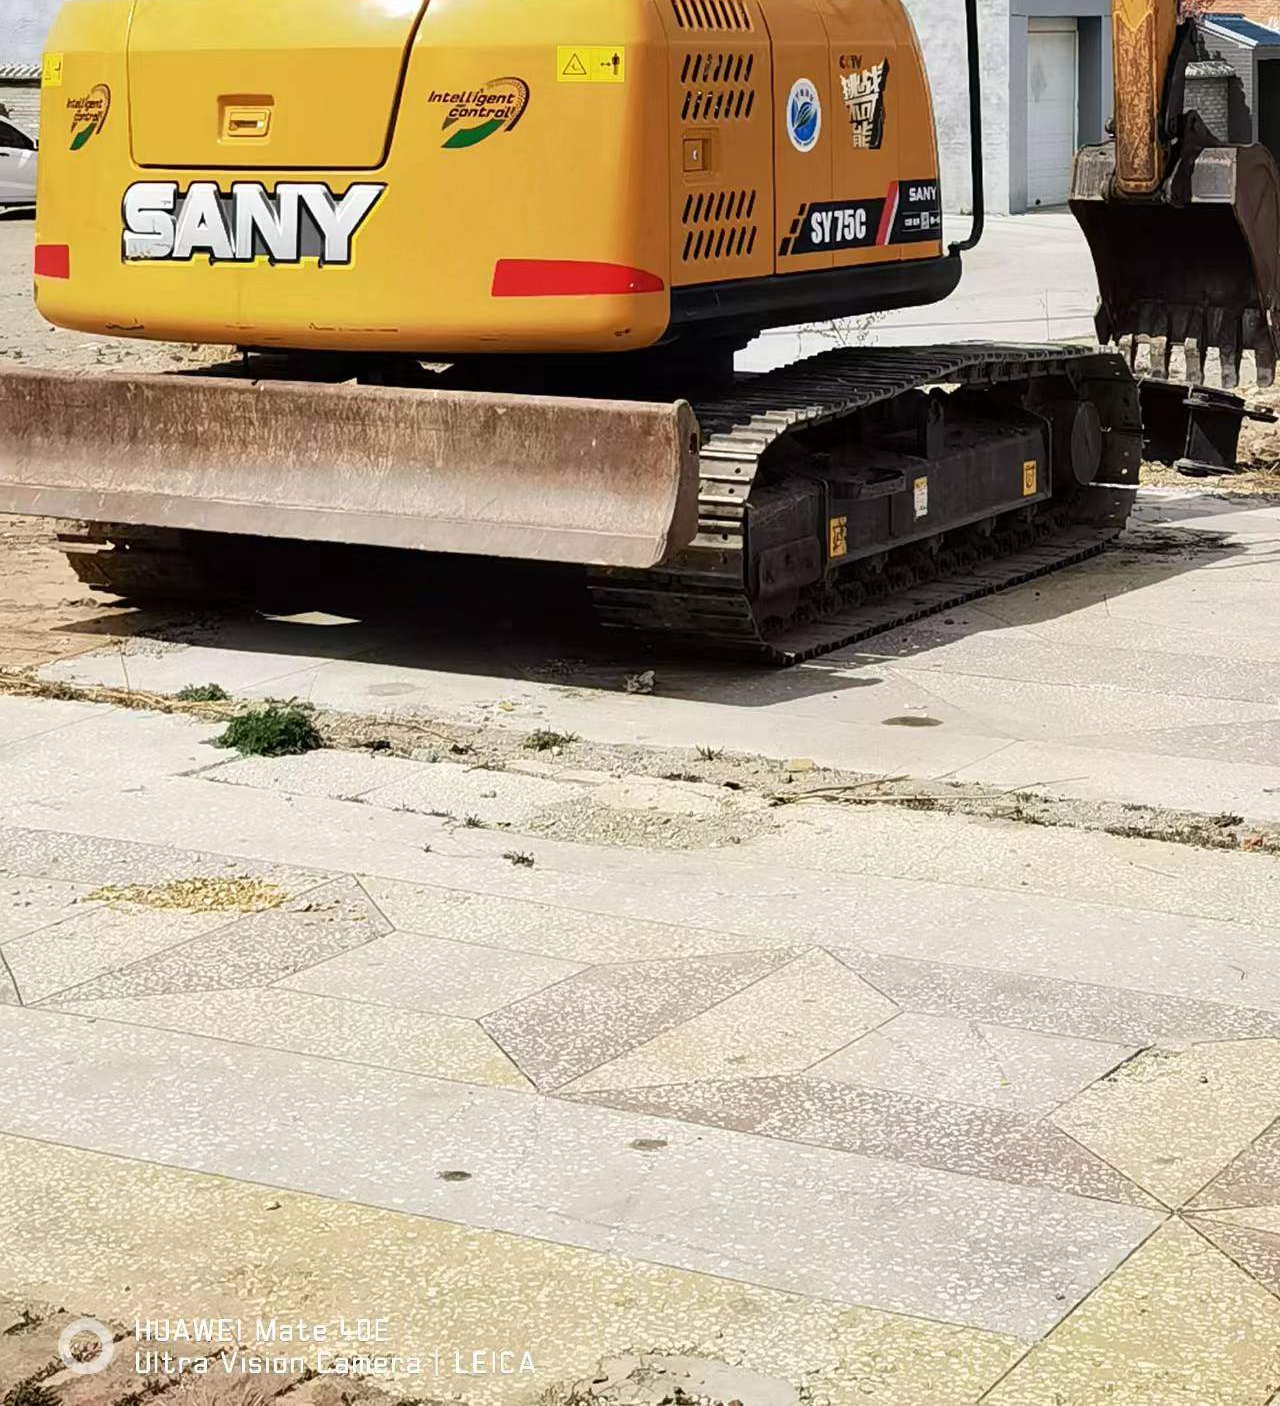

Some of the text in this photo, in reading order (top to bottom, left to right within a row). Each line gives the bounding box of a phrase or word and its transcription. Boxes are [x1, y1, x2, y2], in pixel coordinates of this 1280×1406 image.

[427, 88, 516, 106] Intelligent
[909, 186, 937, 202] SANY
[121, 181, 388, 265] SANY
